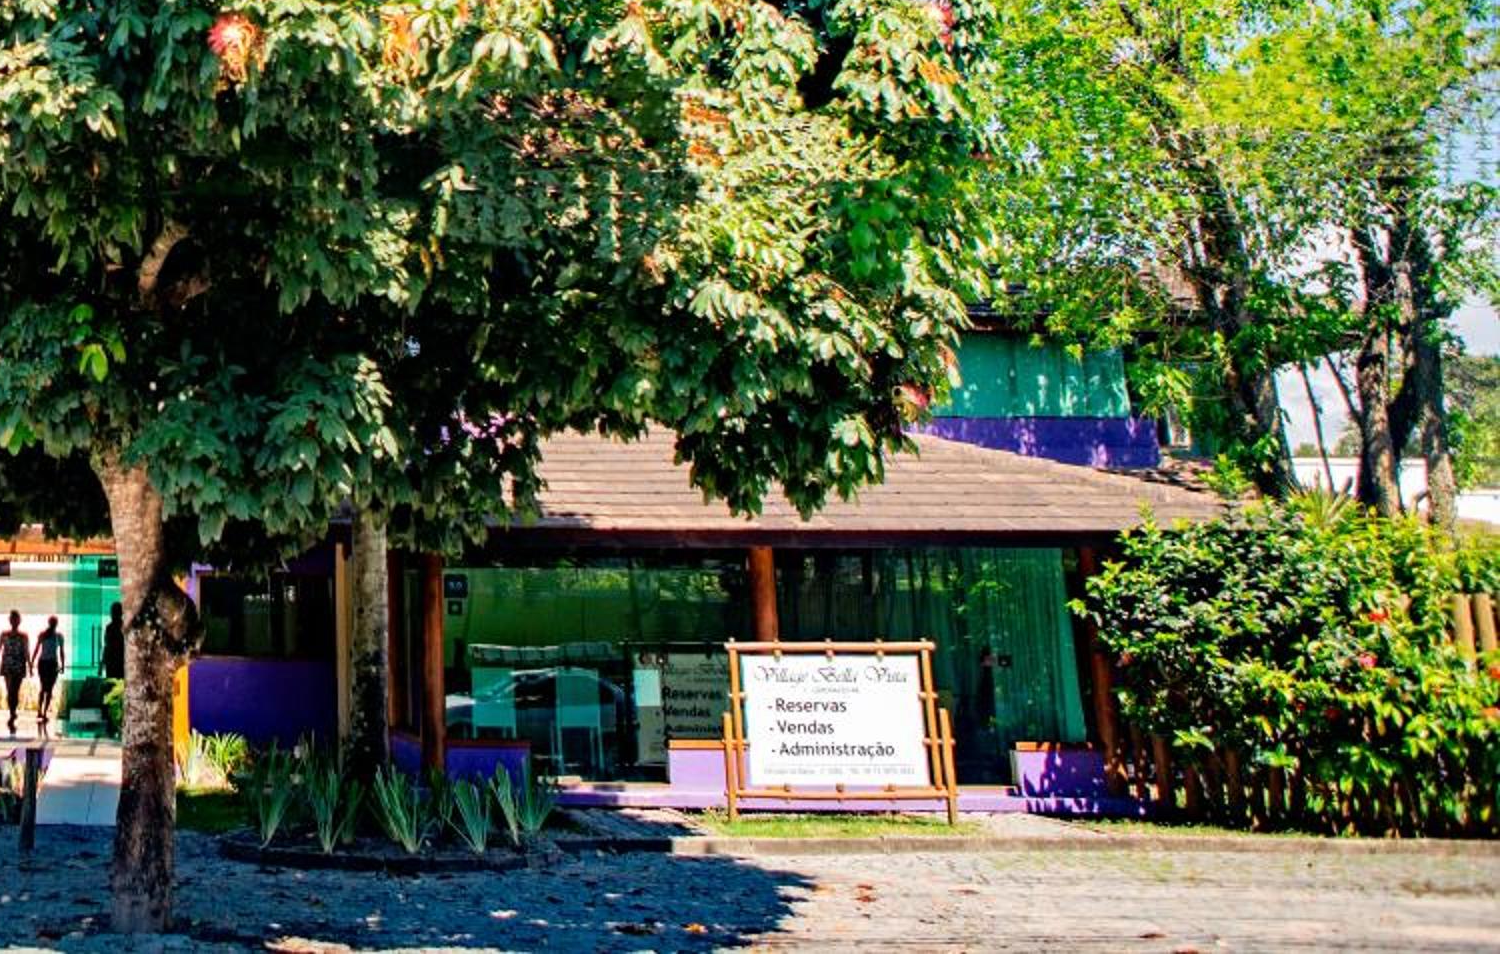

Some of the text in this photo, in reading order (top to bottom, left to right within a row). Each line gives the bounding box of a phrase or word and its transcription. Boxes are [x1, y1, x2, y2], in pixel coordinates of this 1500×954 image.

[754, 665, 908, 688] Village Bella Vista
[775, 697, 847, 713] Reservas
[777, 719, 835, 734] Vendas
[779, 741, 895, 759] Administração
